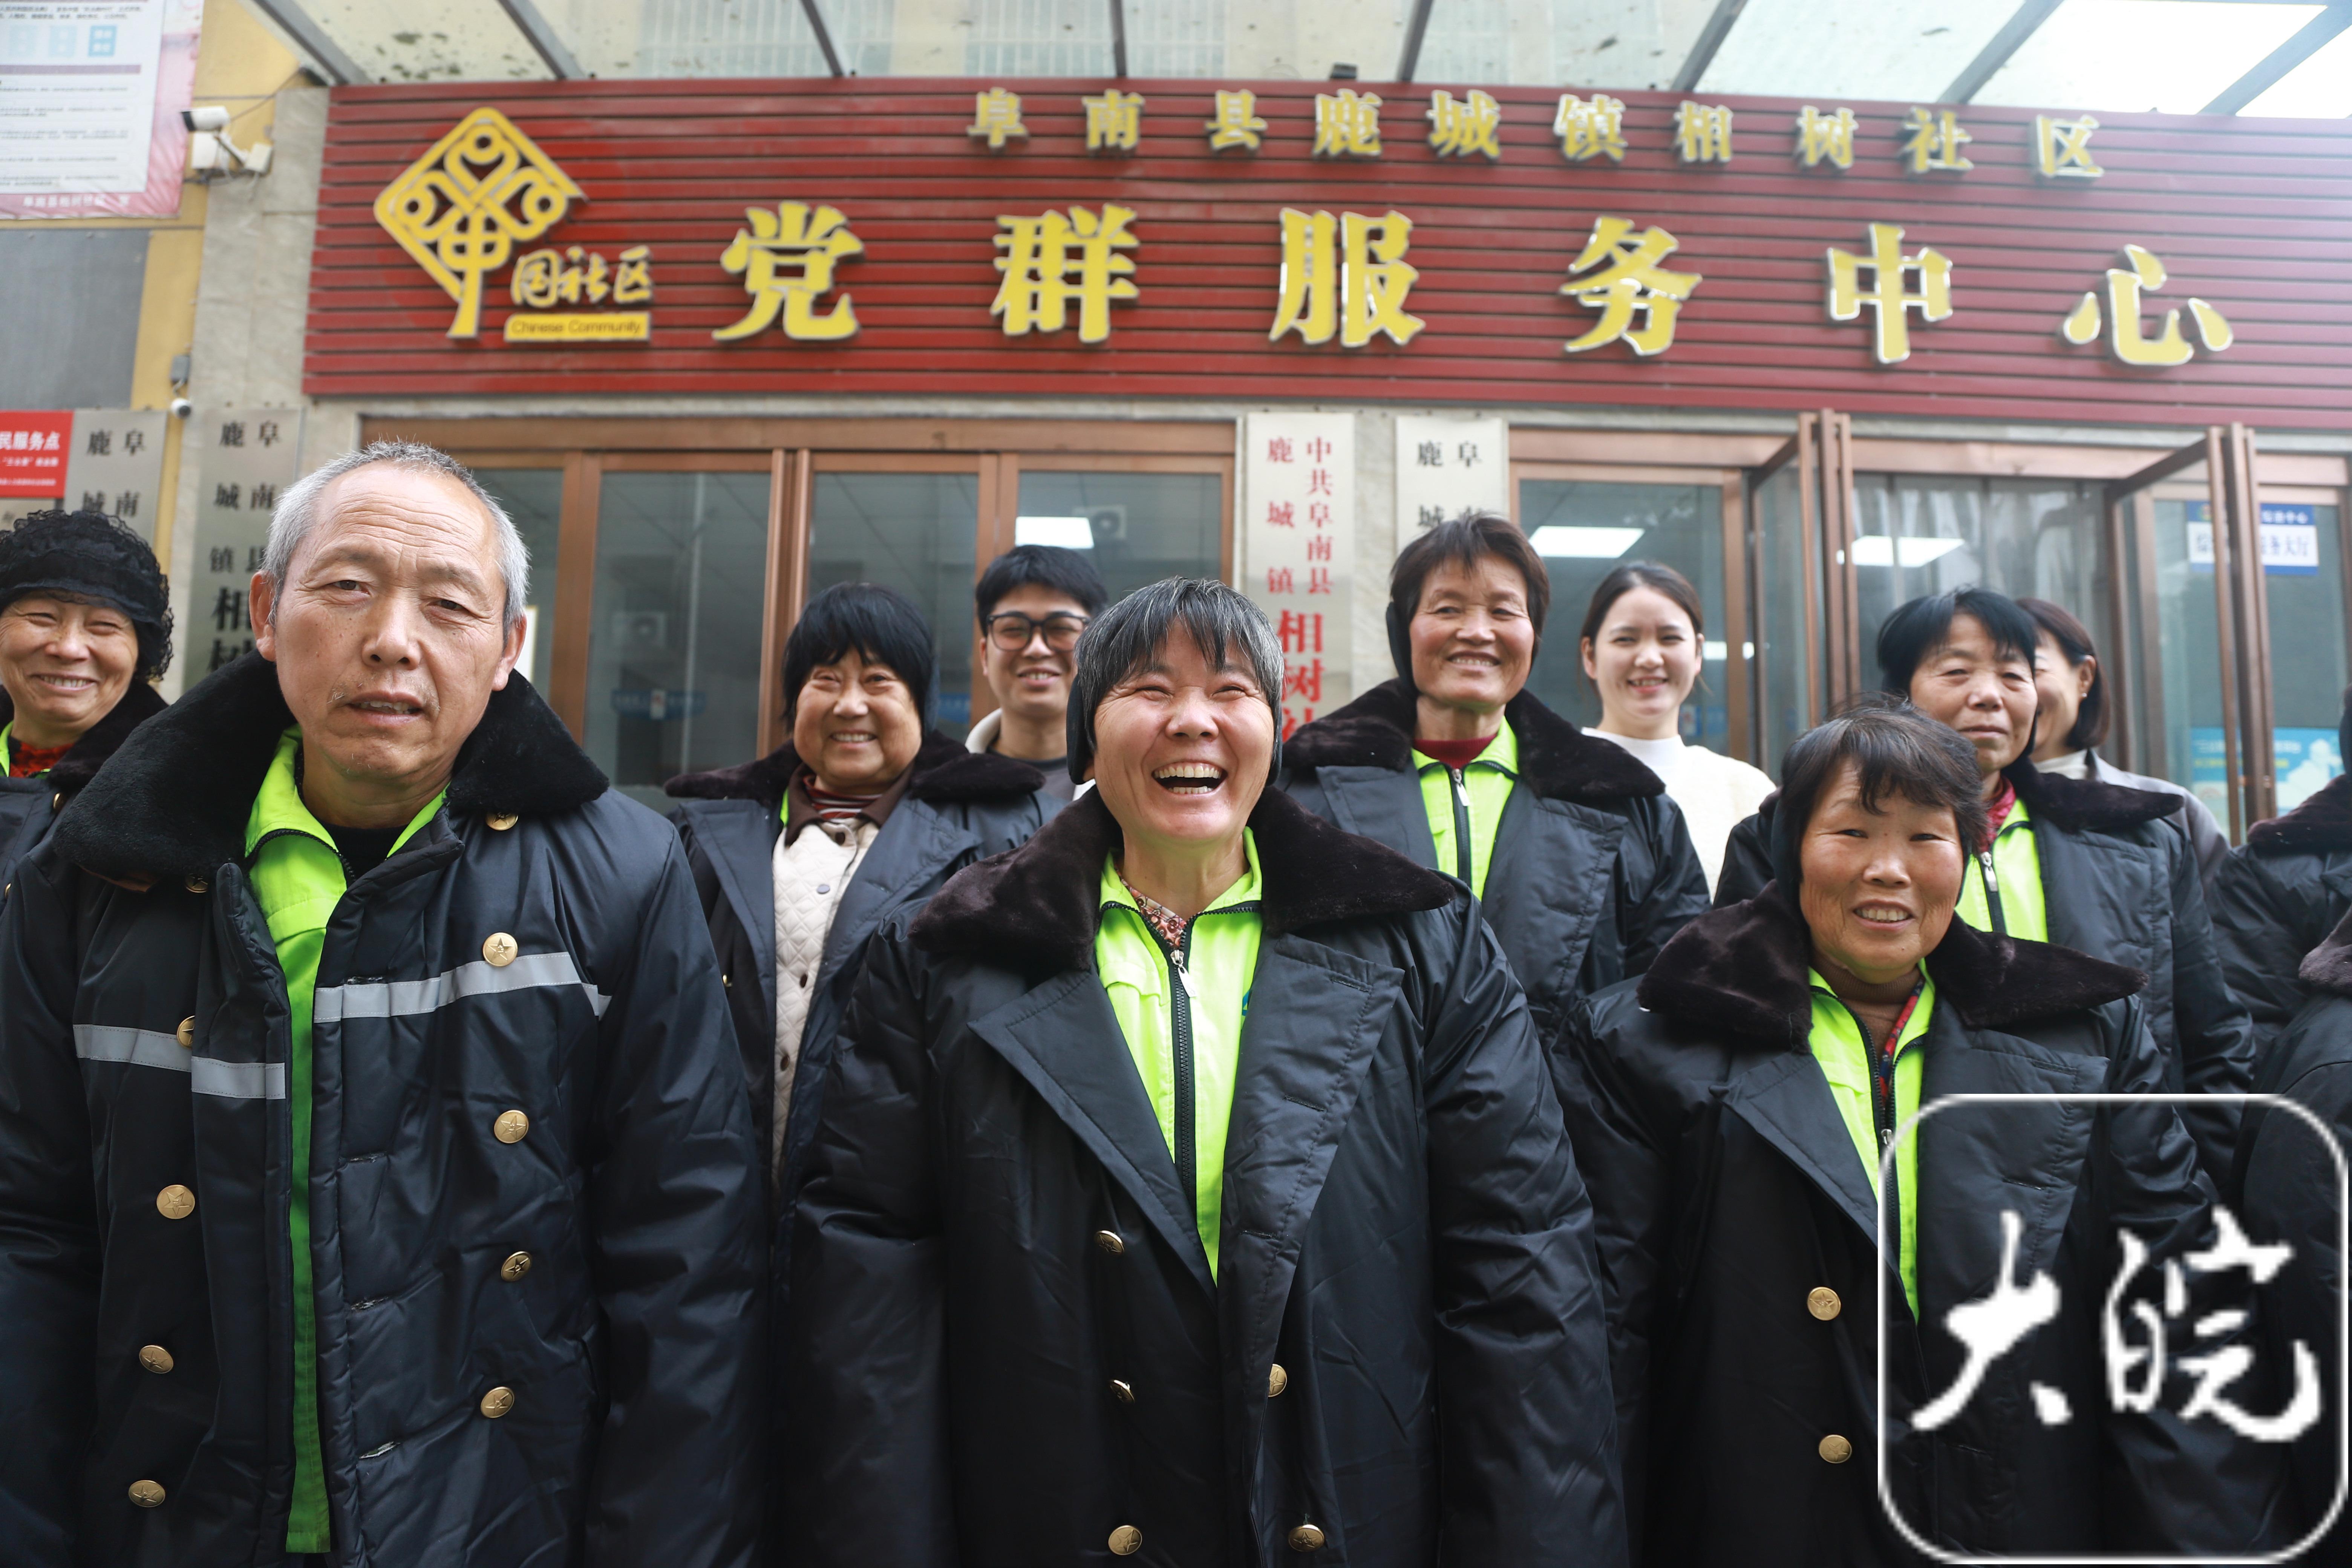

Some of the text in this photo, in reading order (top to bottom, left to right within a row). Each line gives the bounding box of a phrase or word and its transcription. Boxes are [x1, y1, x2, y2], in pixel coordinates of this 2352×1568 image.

[967, 87, 2103, 178] 阜南县鹿城镇相树社区
[511, 319, 640, 336] Chinese Community
[711, 201, 2234, 366] 党群服务中心
[1266, 436, 1295, 595] 鹿城镇
[1305, 436, 1335, 595] 中共阜南县
